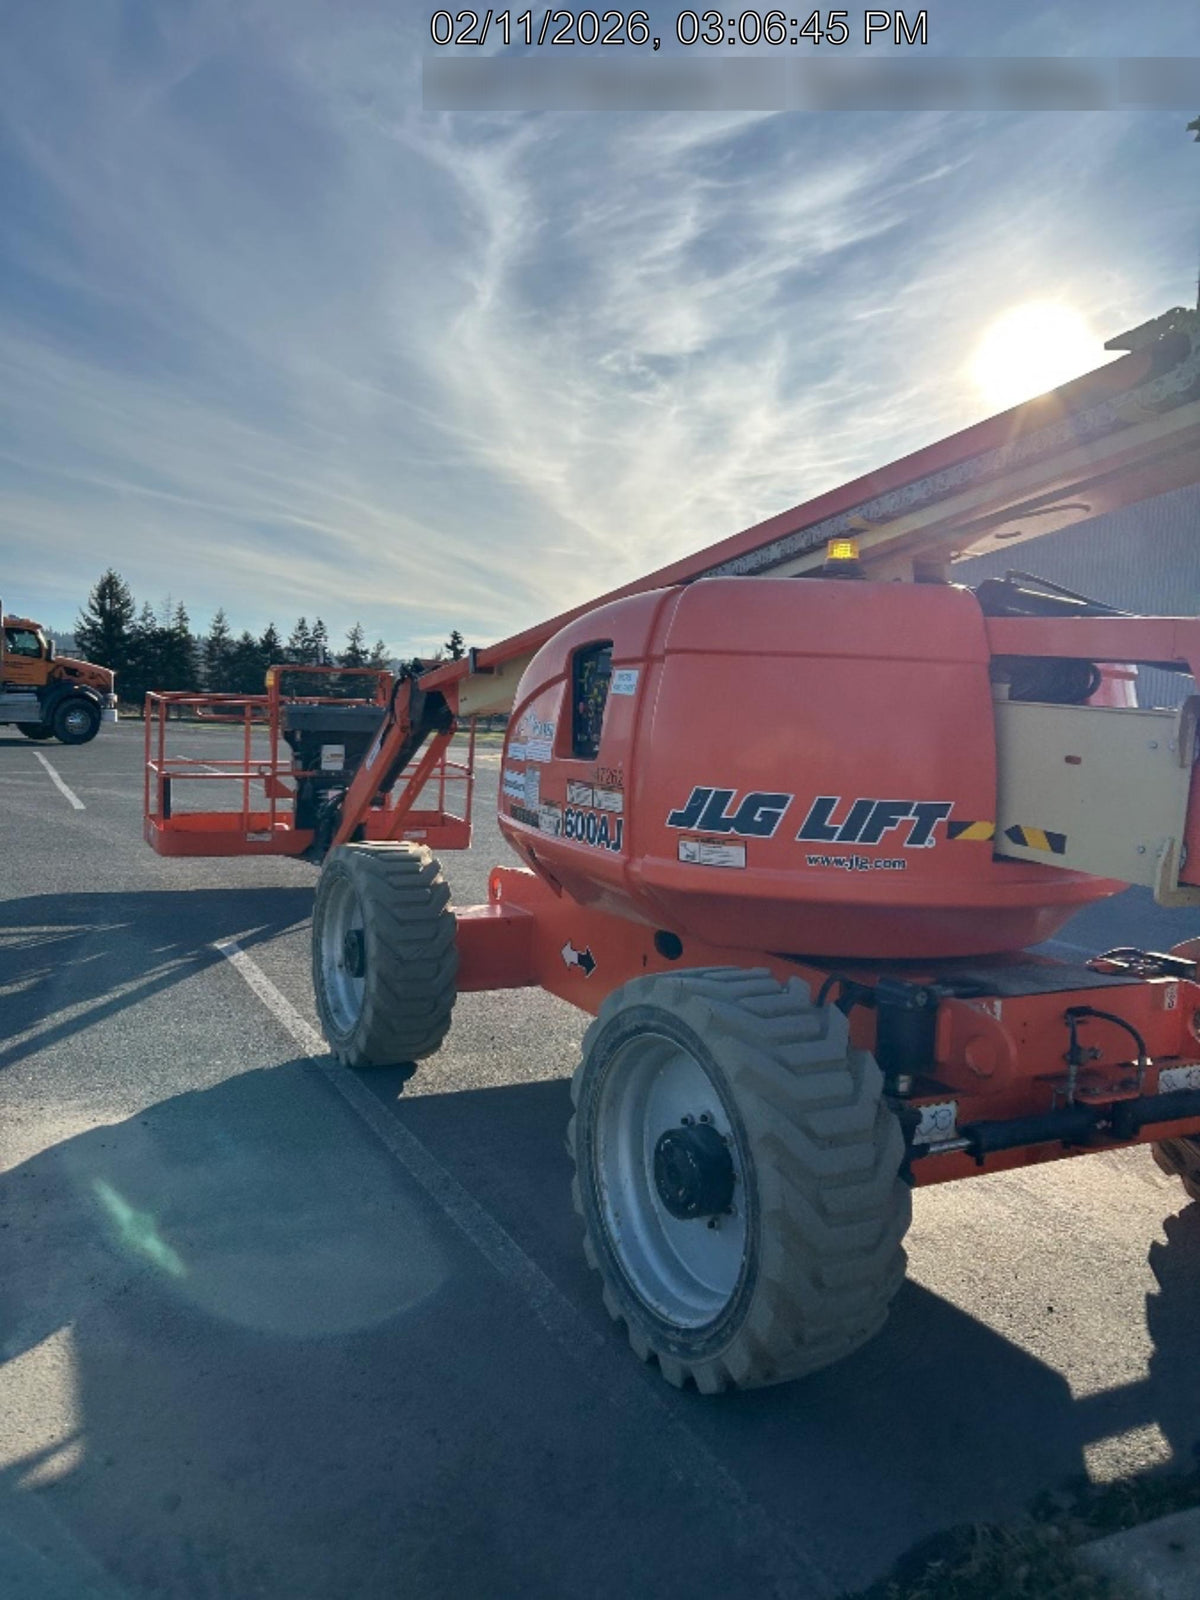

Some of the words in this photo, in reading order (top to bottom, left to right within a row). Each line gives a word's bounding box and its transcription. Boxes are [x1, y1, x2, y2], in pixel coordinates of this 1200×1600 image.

[563, 807, 624, 852] 600AJ
[666, 785, 794, 838] JLG
[796, 795, 955, 848] LIFT
[806, 853, 907, 871] www.jlg.com
